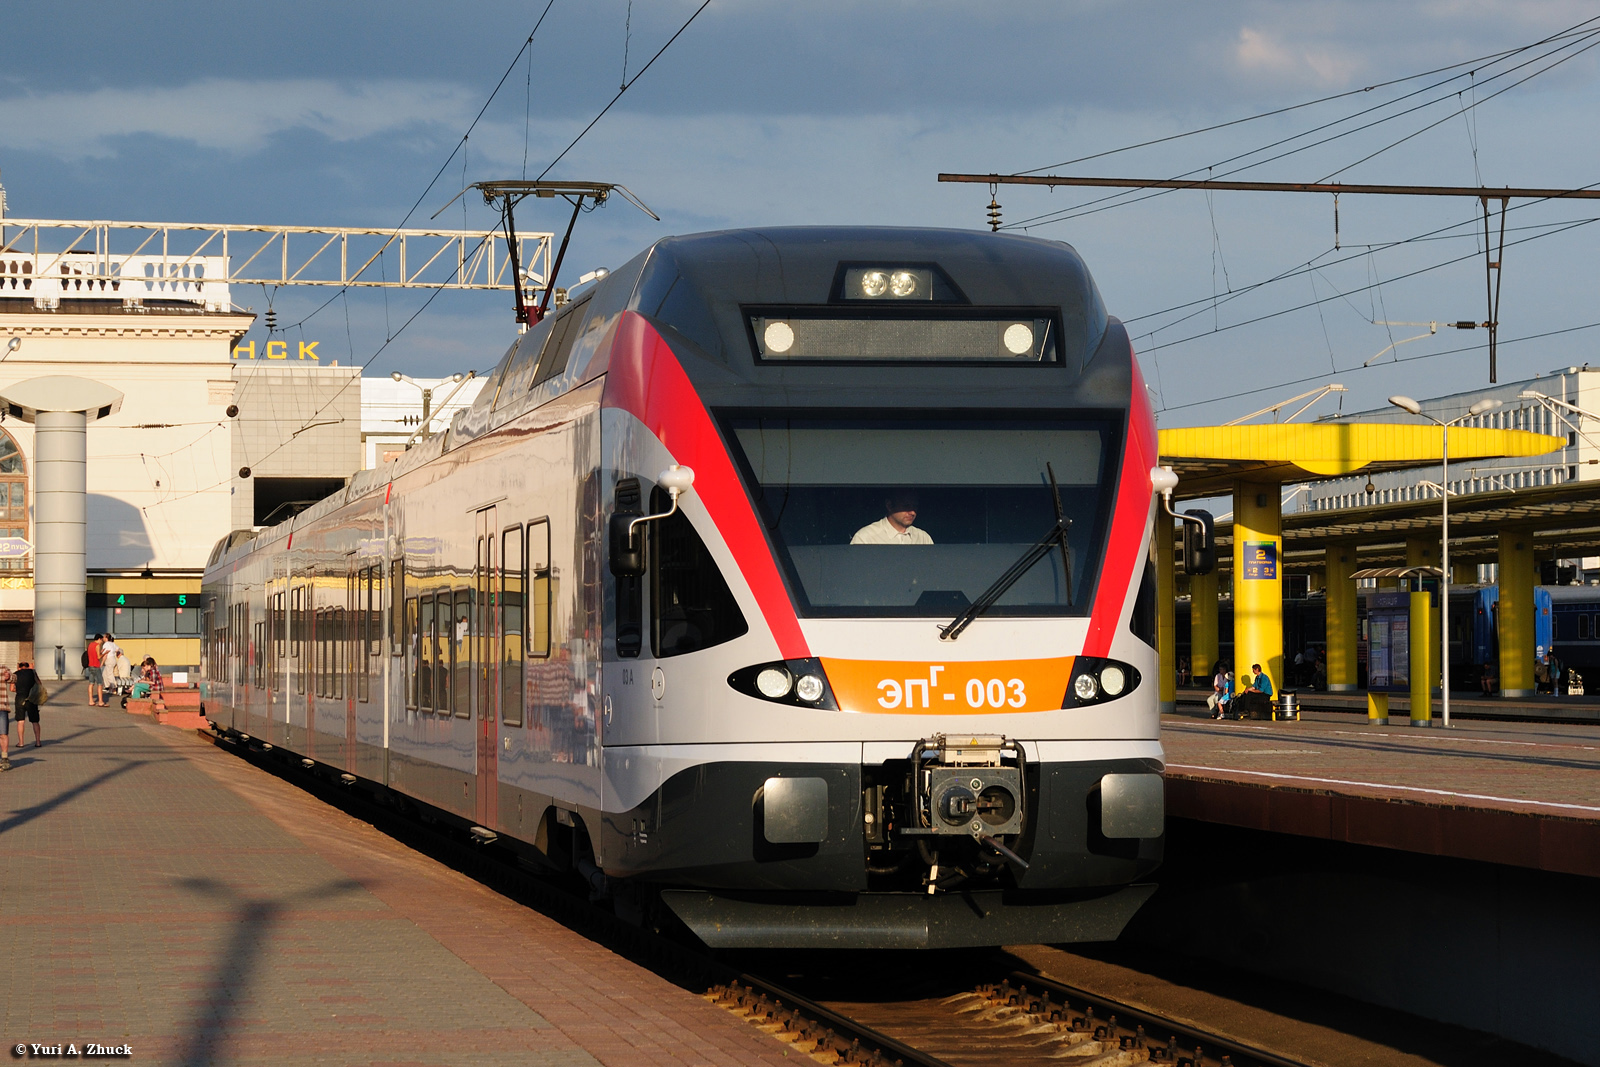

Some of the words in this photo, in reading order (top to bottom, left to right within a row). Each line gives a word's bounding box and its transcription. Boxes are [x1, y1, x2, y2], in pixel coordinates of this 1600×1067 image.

[1256, 549, 1266, 560] 2
[117, 594, 125, 605] 4
[178, 595, 187, 605] 5
